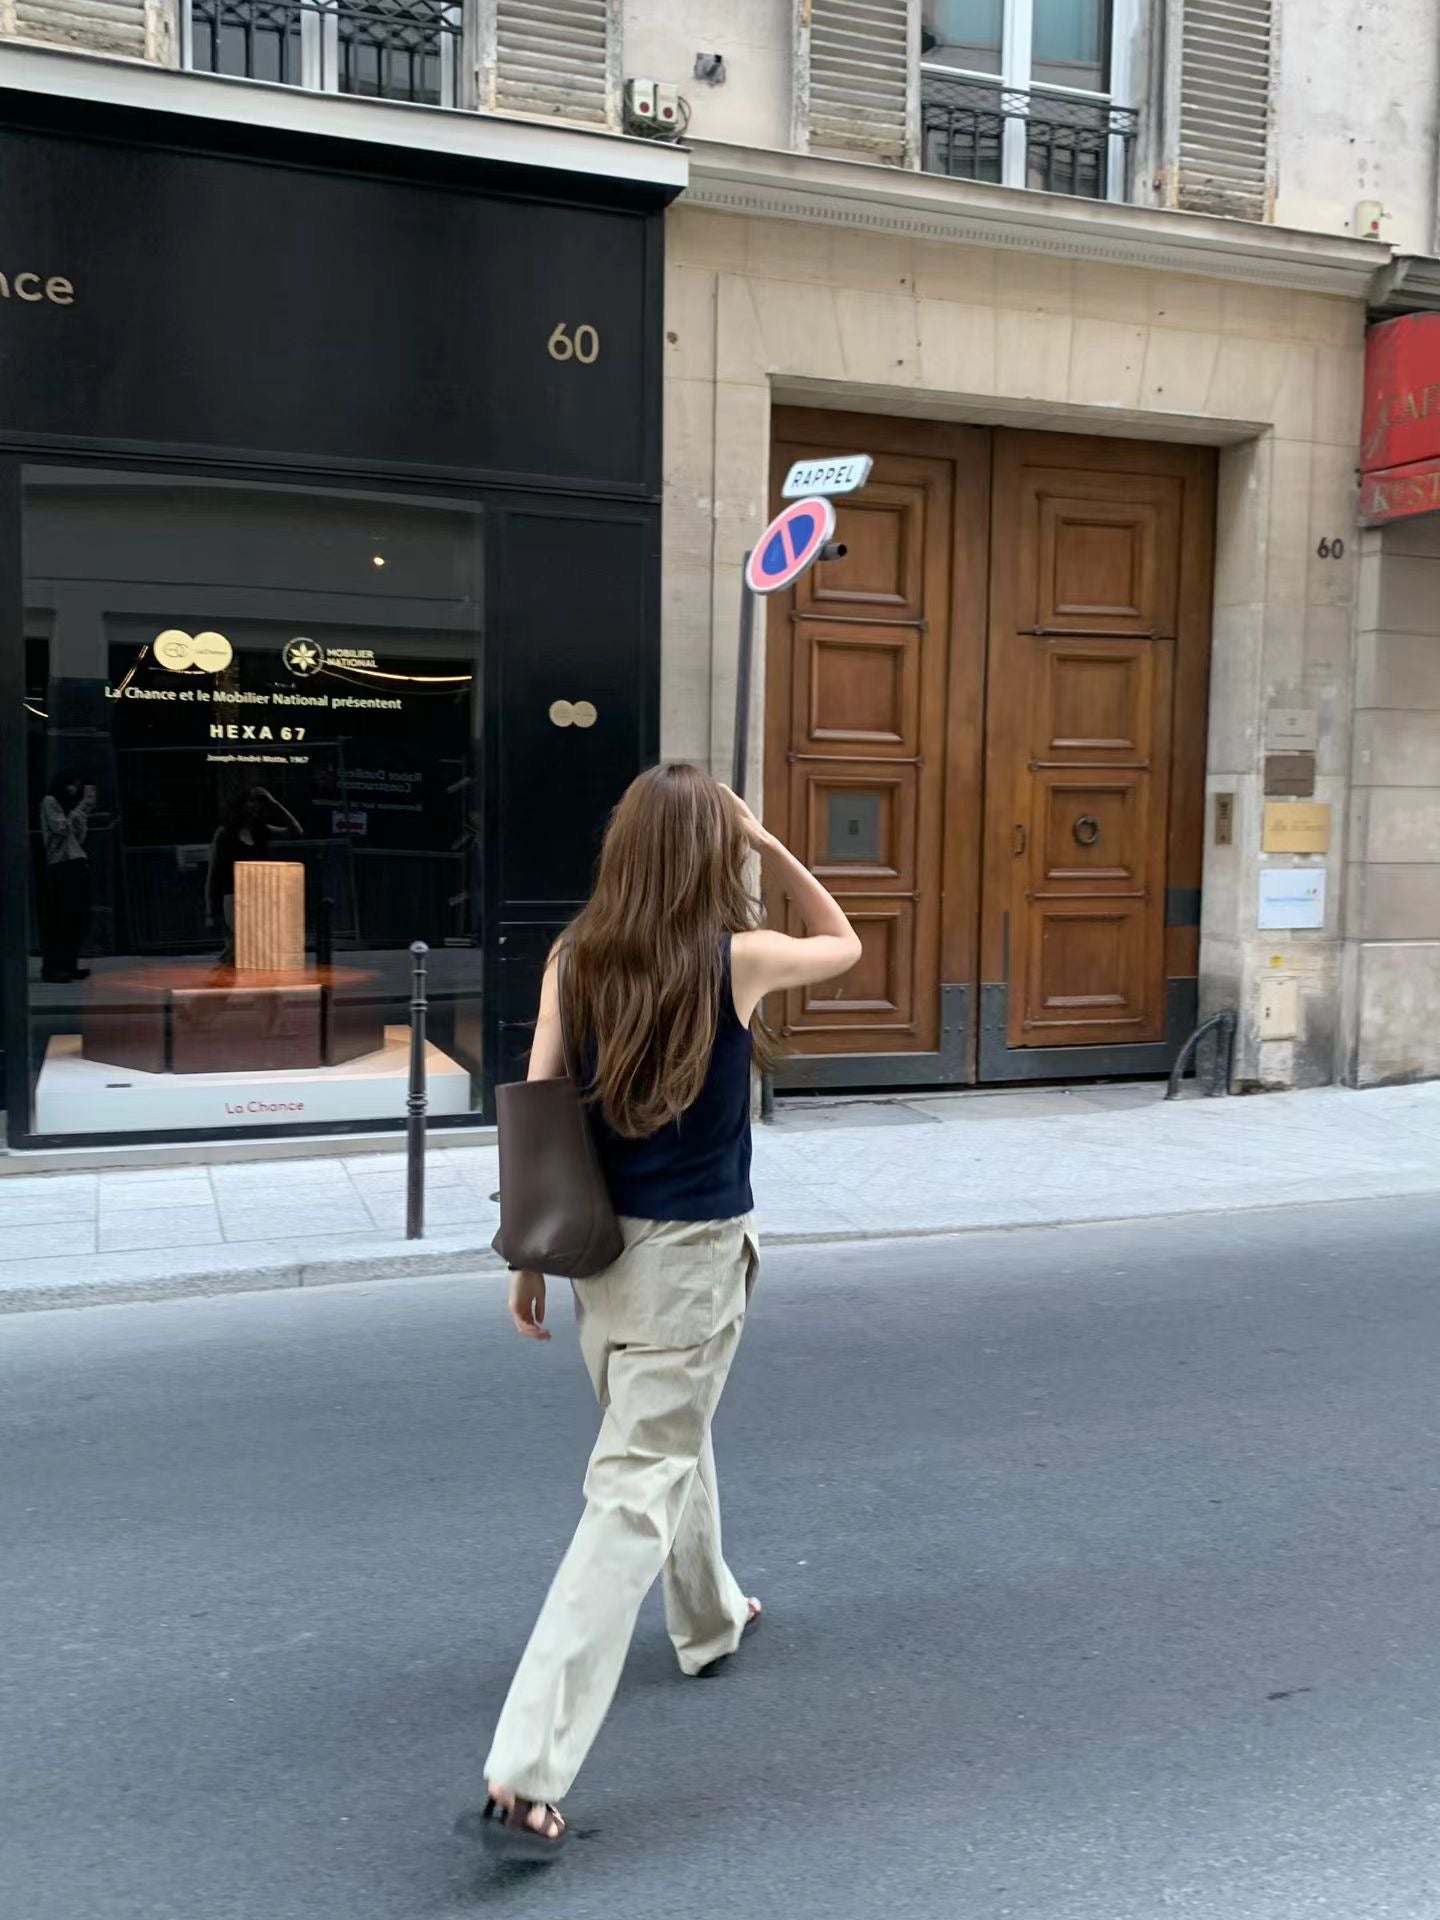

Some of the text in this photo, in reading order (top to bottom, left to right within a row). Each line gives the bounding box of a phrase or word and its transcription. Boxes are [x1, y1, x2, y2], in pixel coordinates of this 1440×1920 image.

[547, 322, 600, 364] 60
[791, 464, 854, 488] RAPPEL
[1317, 536, 1344, 559] 60
[327, 648, 375, 659] MOBILIER
[327, 657, 379, 669] NATIONAL
[104, 686, 402, 710] La Chance et le Mobilier National présentent
[210, 724, 306, 741] HEXA 67
[225, 1100, 305, 1114] La Chance
